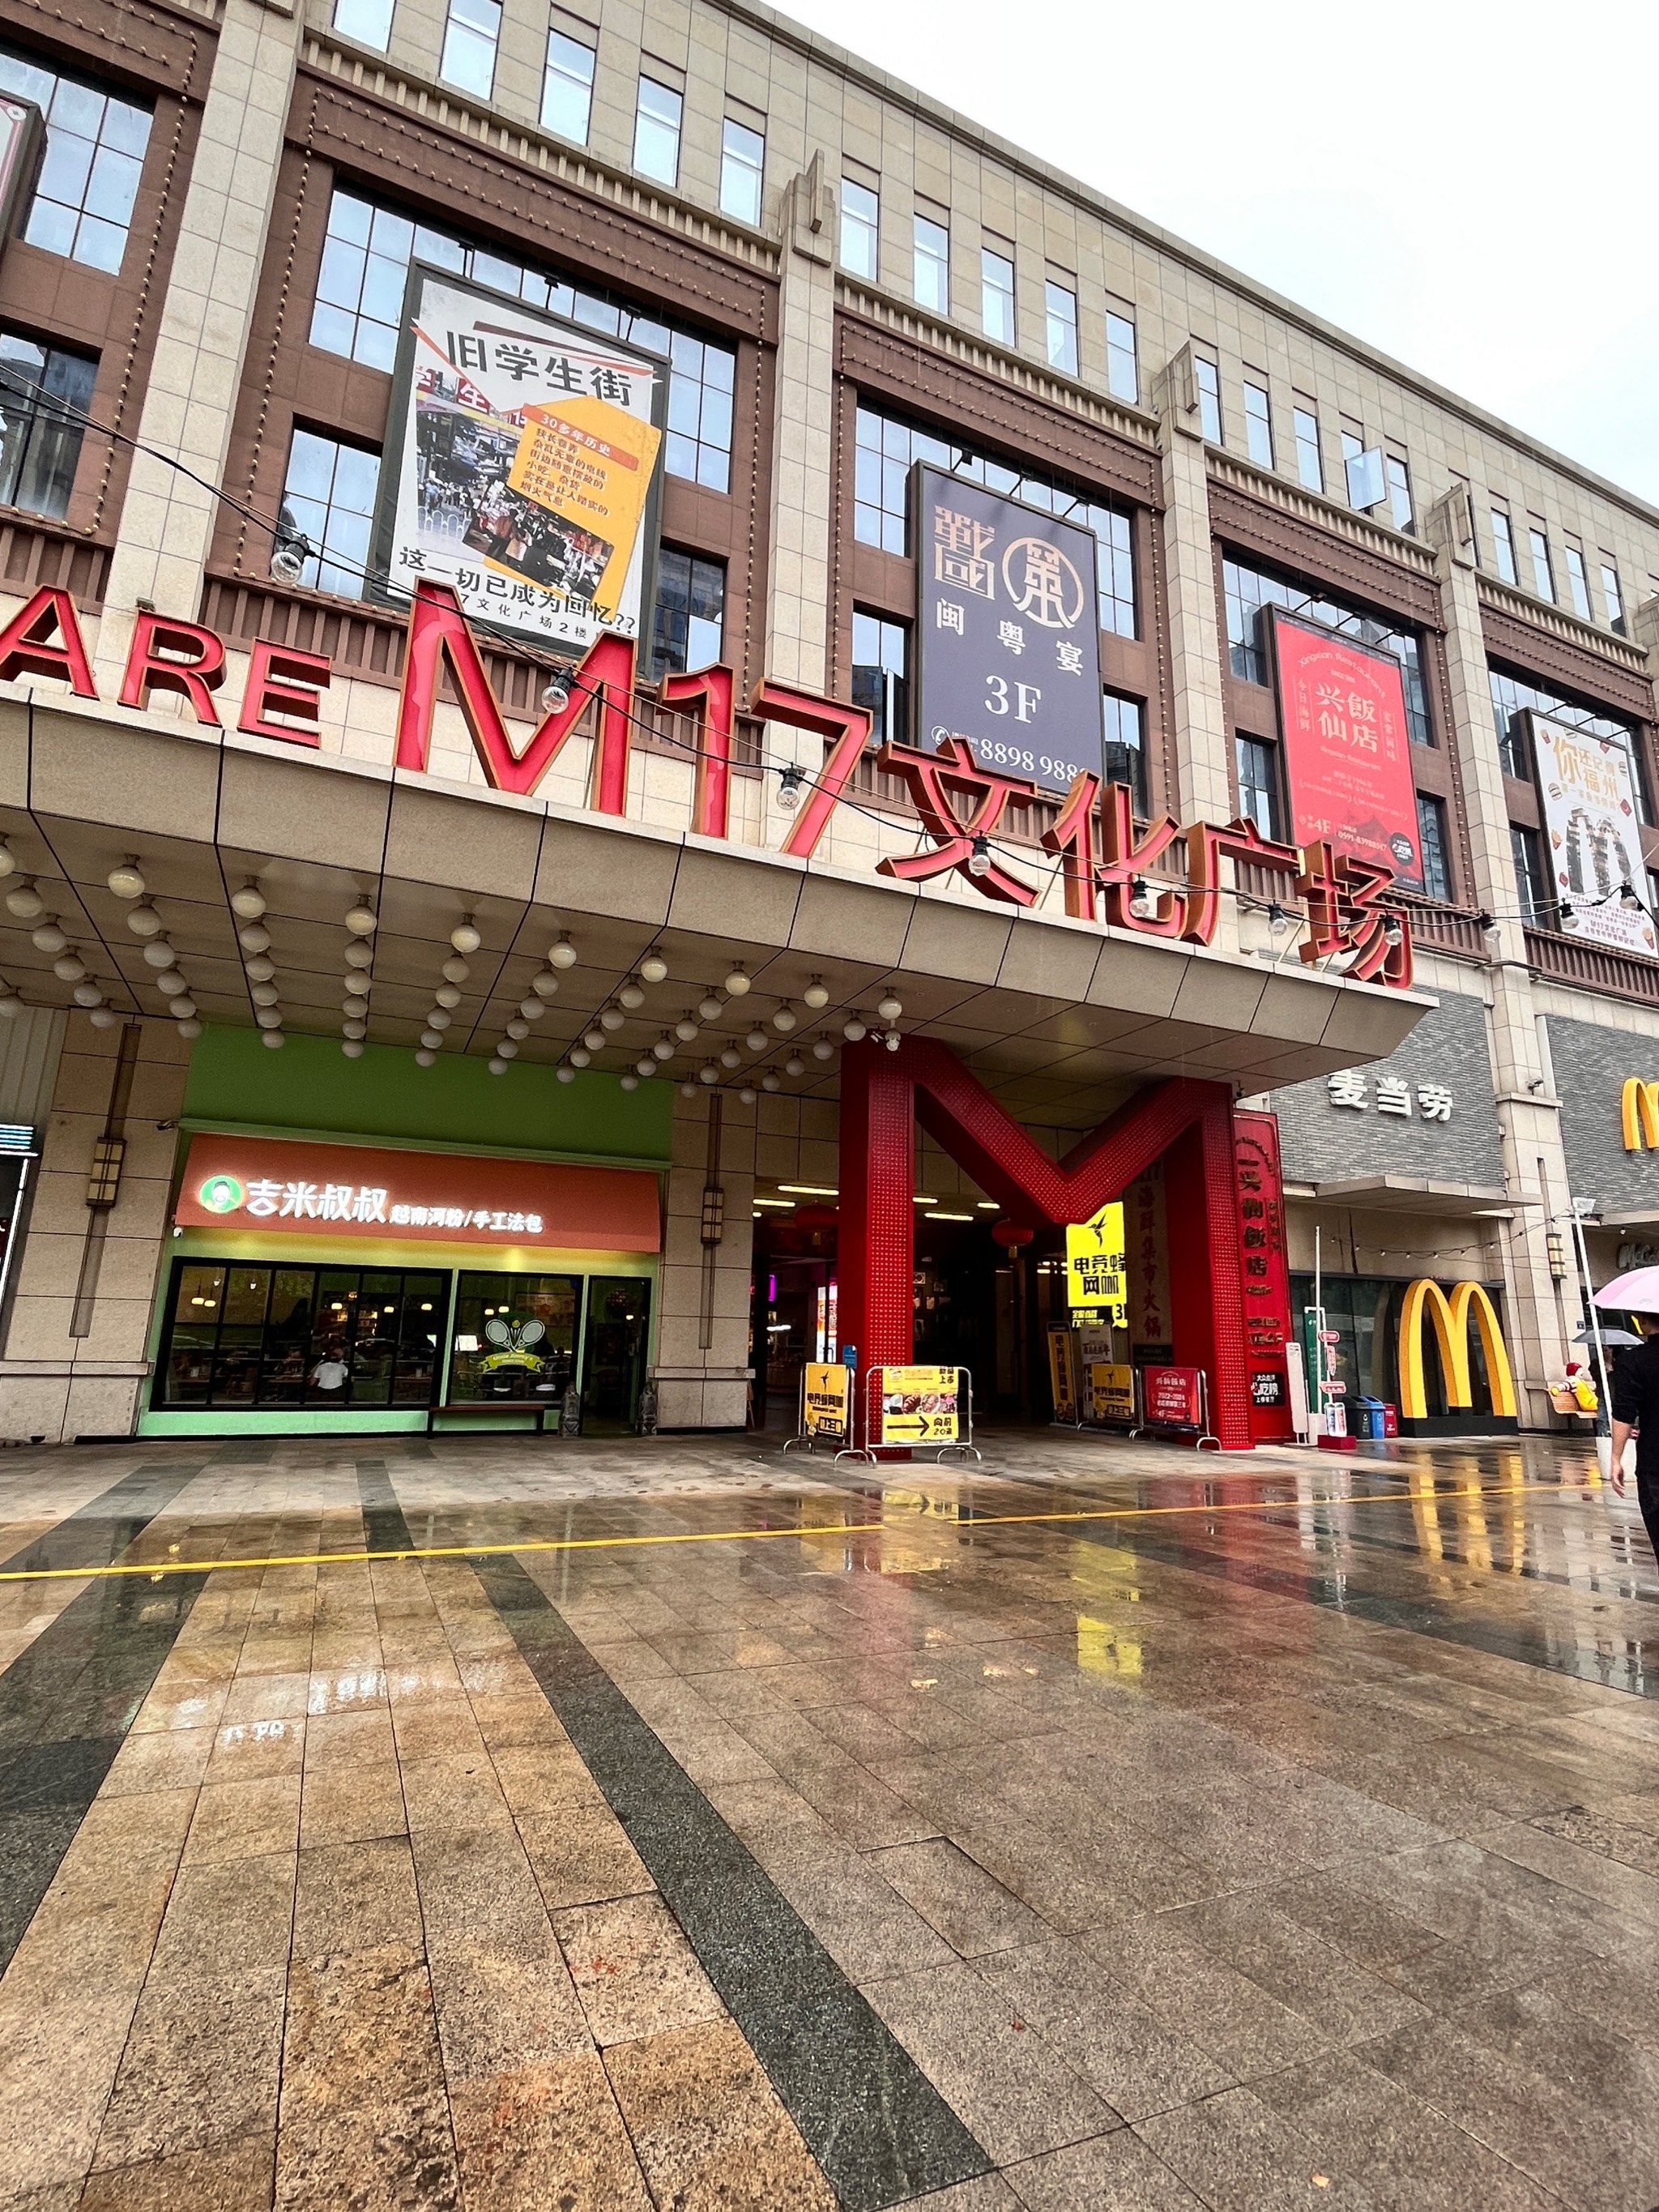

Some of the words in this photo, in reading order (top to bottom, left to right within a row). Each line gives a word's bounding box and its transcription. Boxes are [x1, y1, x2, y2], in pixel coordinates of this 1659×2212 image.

[446, 330, 632, 407] 旧学生街
[541, 413, 611, 457] 30多年历史
[520, 480, 564, 507] 烟火气息
[936, 597, 1084, 677] 闽粤宴
[984, 674, 1042, 724] 3F
[979, 738, 1035, 772] 8898
[1039, 755, 1086, 784] 988
[1328, 1068, 1453, 1122] 麦当劳
[245, 1178, 389, 1224] 吉米叔叔
[389, 1203, 545, 1234] 越南河粉/手工法包
